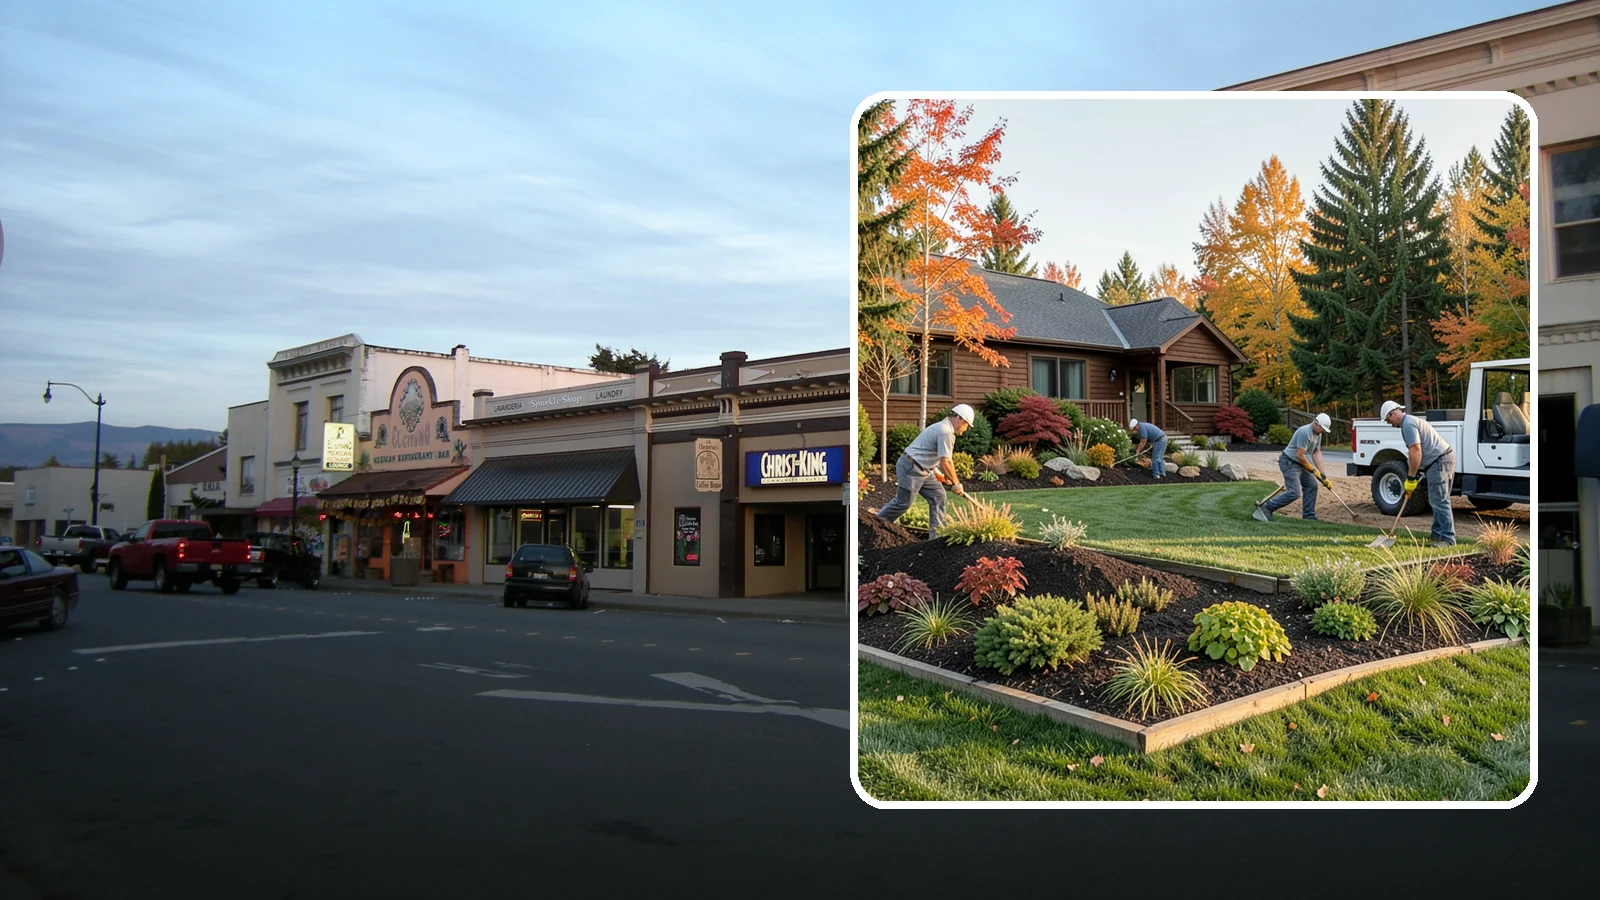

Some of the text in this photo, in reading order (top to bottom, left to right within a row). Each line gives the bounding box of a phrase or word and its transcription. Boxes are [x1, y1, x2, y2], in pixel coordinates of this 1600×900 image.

[561, 394, 582, 405] Shop
[595, 389, 624, 400] LAUNDRY
[493, 402, 523, 413] LAVANDERIA
[373, 455, 396, 464] MEXICAN
[397, 451, 434, 463] RESTAURANT
[438, 450, 450, 459] BAR
[761, 449, 828, 478] CHRIST KING
